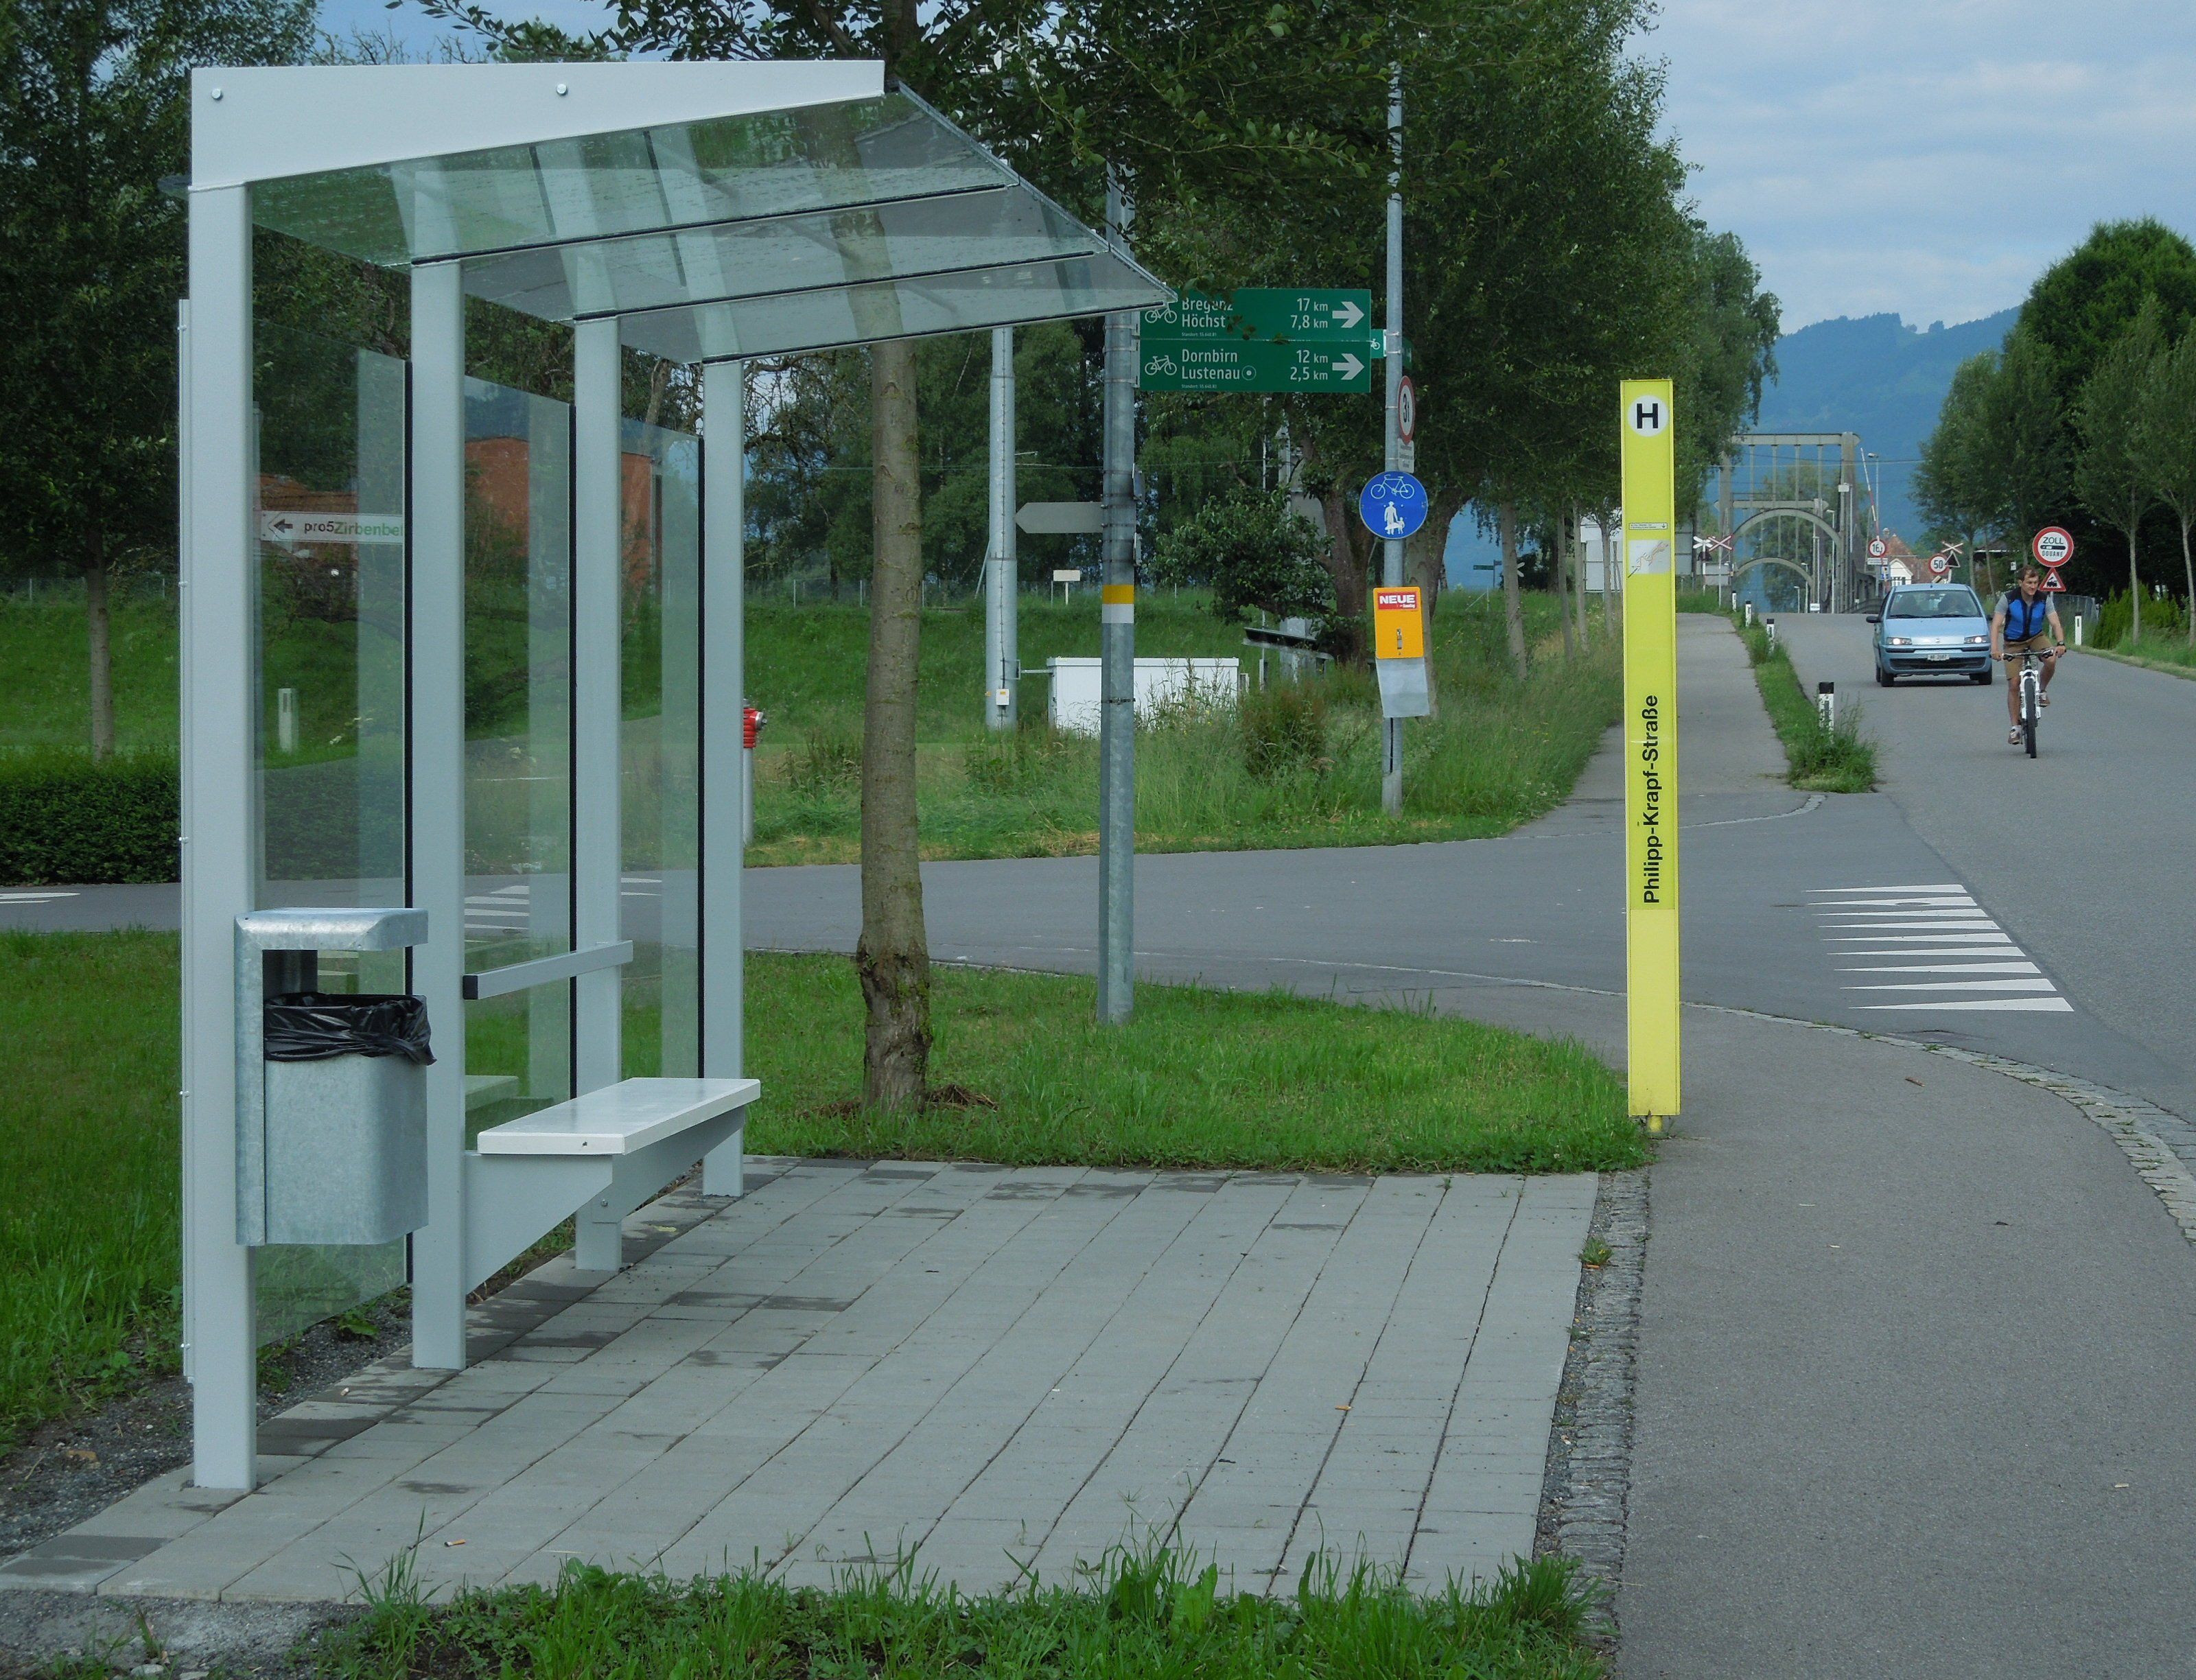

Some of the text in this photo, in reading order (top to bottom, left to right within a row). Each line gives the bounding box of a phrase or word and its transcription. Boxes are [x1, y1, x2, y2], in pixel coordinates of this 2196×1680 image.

[1297, 298, 1310, 311] 17
[1313, 301, 1329, 312] km
[1182, 314, 1328, 331] Höchst 7,8 km
[1182, 349, 1328, 363] Dornbirn 12 km
[1182, 366, 1328, 382] Lustenau 2,5 km
[1636, 403, 1659, 429] H
[1934, 559, 1943, 569] 50
[1379, 594, 1415, 604] NEUE
[1642, 695, 1663, 903] Philipp-Krapf-Straße
